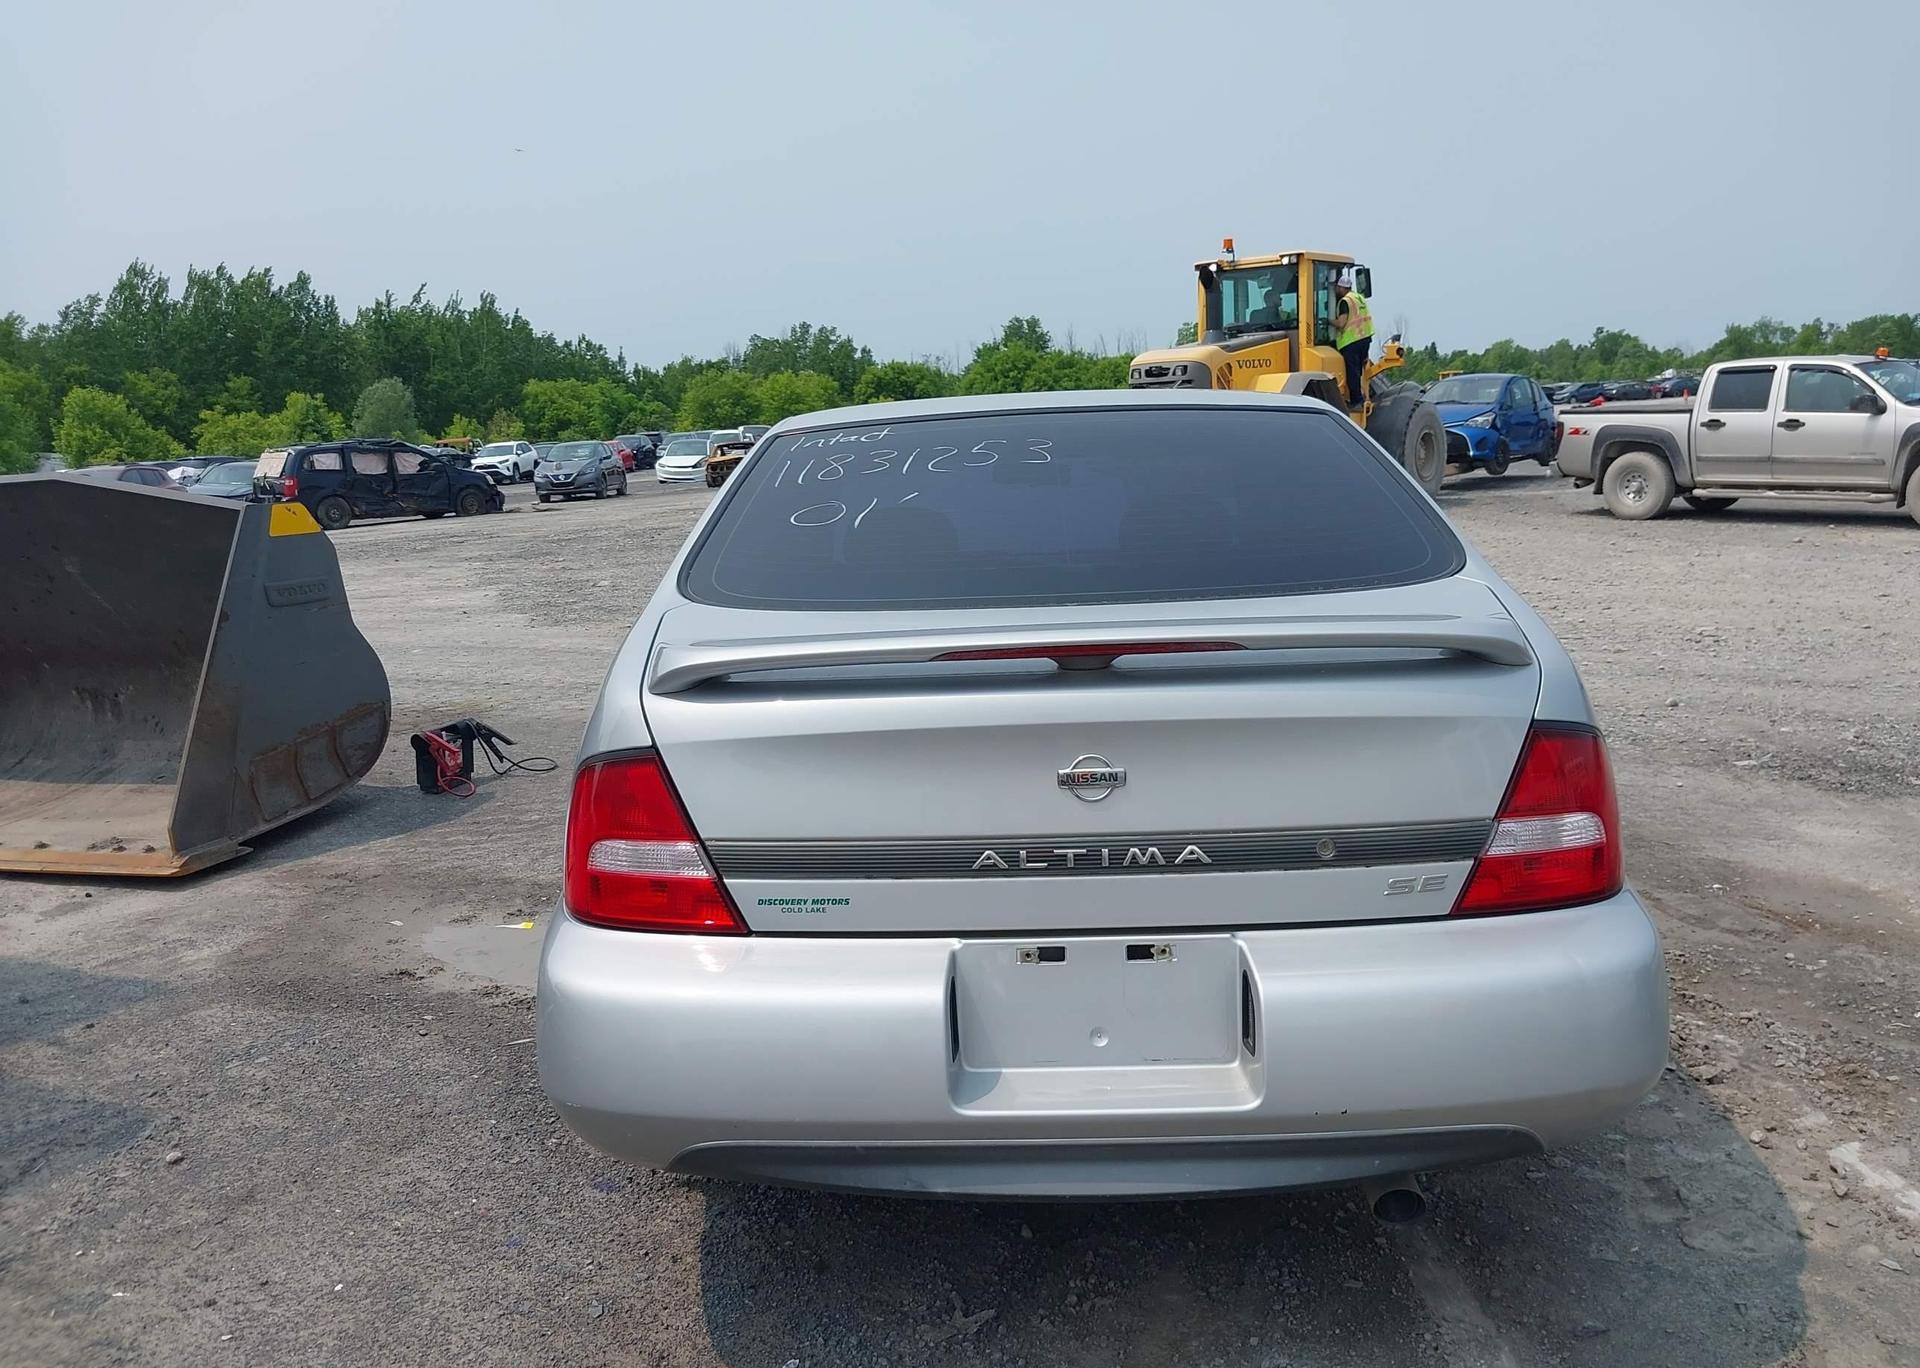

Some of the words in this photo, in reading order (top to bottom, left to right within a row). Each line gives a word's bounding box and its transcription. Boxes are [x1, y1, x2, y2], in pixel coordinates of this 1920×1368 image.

[1235, 358, 1272, 370] VOLVO
[774, 439, 1053, 488] 11831253
[1066, 772, 1119, 784] NISSAN
[971, 844, 1213, 870] ALTIMA
[1383, 873, 1449, 896] SE
[757, 898, 809, 906] DISCOVERY
[811, 897, 851, 906] MOTORS
[780, 906, 803, 914] COLD
[805, 906, 828, 914] LAKE
